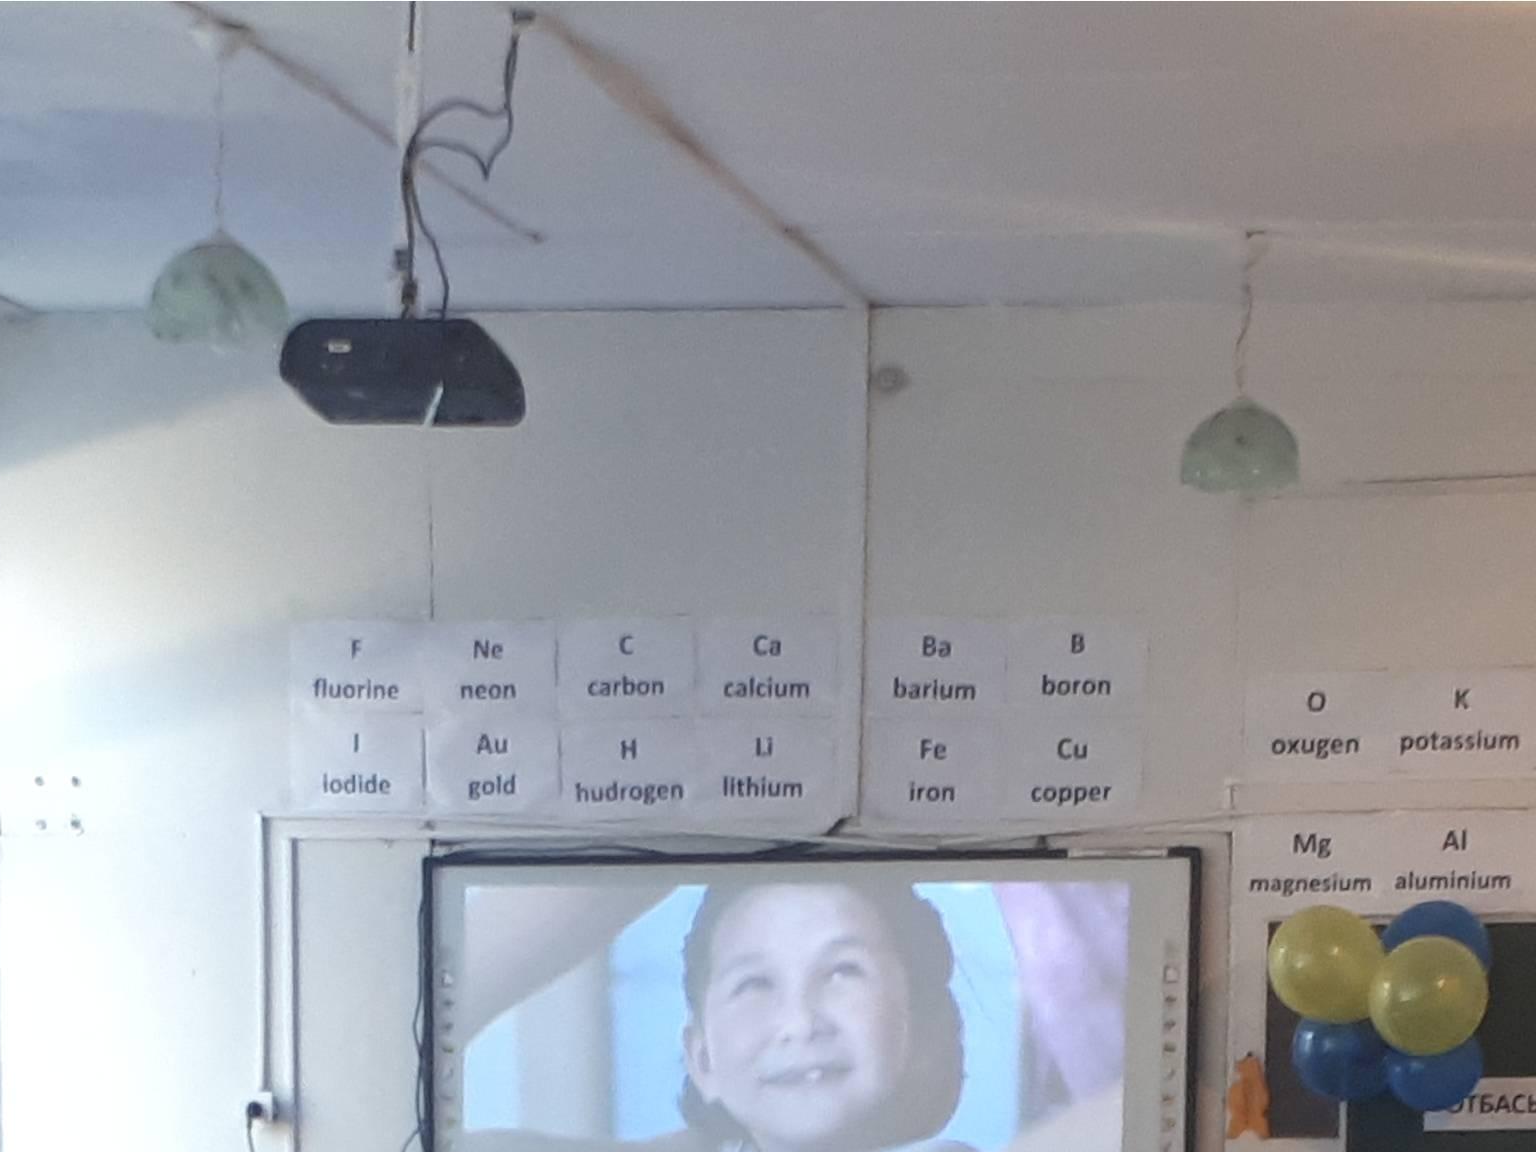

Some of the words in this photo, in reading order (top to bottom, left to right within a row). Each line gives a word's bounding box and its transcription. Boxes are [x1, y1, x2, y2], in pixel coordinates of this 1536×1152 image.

[351, 639, 361, 658] F
[473, 639, 503, 659] Ne
[618, 634, 634, 656] C
[753, 634, 782, 657] Ca
[922, 635, 952, 658] Ba
[1070, 633, 1085, 654] B
[312, 677, 399, 699] fluorine
[460, 683, 517, 700] neon
[587, 675, 665, 697] carbon
[723, 676, 810, 698] calcium
[893, 676, 976, 700] barium
[1041, 674, 1111, 696] boron
[1306, 691, 1327, 713] O
[1454, 688, 1470, 710] K
[476, 733, 508, 755] Au
[620, 738, 637, 760] H
[755, 736, 773, 757] Li
[920, 738, 947, 761] Fe
[1057, 737, 1088, 760] Cu
[1271, 737, 1360, 759] oxugen
[1400, 730, 1520, 755] potassium
[322, 773, 391, 794] iodide
[468, 773, 516, 800] gold
[575, 781, 684, 805] hudrogen
[723, 776, 803, 797] lithium
[909, 782, 955, 802] iron
[1030, 786, 1112, 805] copper
[1293, 833, 1332, 859] Mg
[1442, 829, 1467, 851] Al
[1249, 874, 1372, 897] magnesium
[1394, 870, 1512, 890] aluminium
